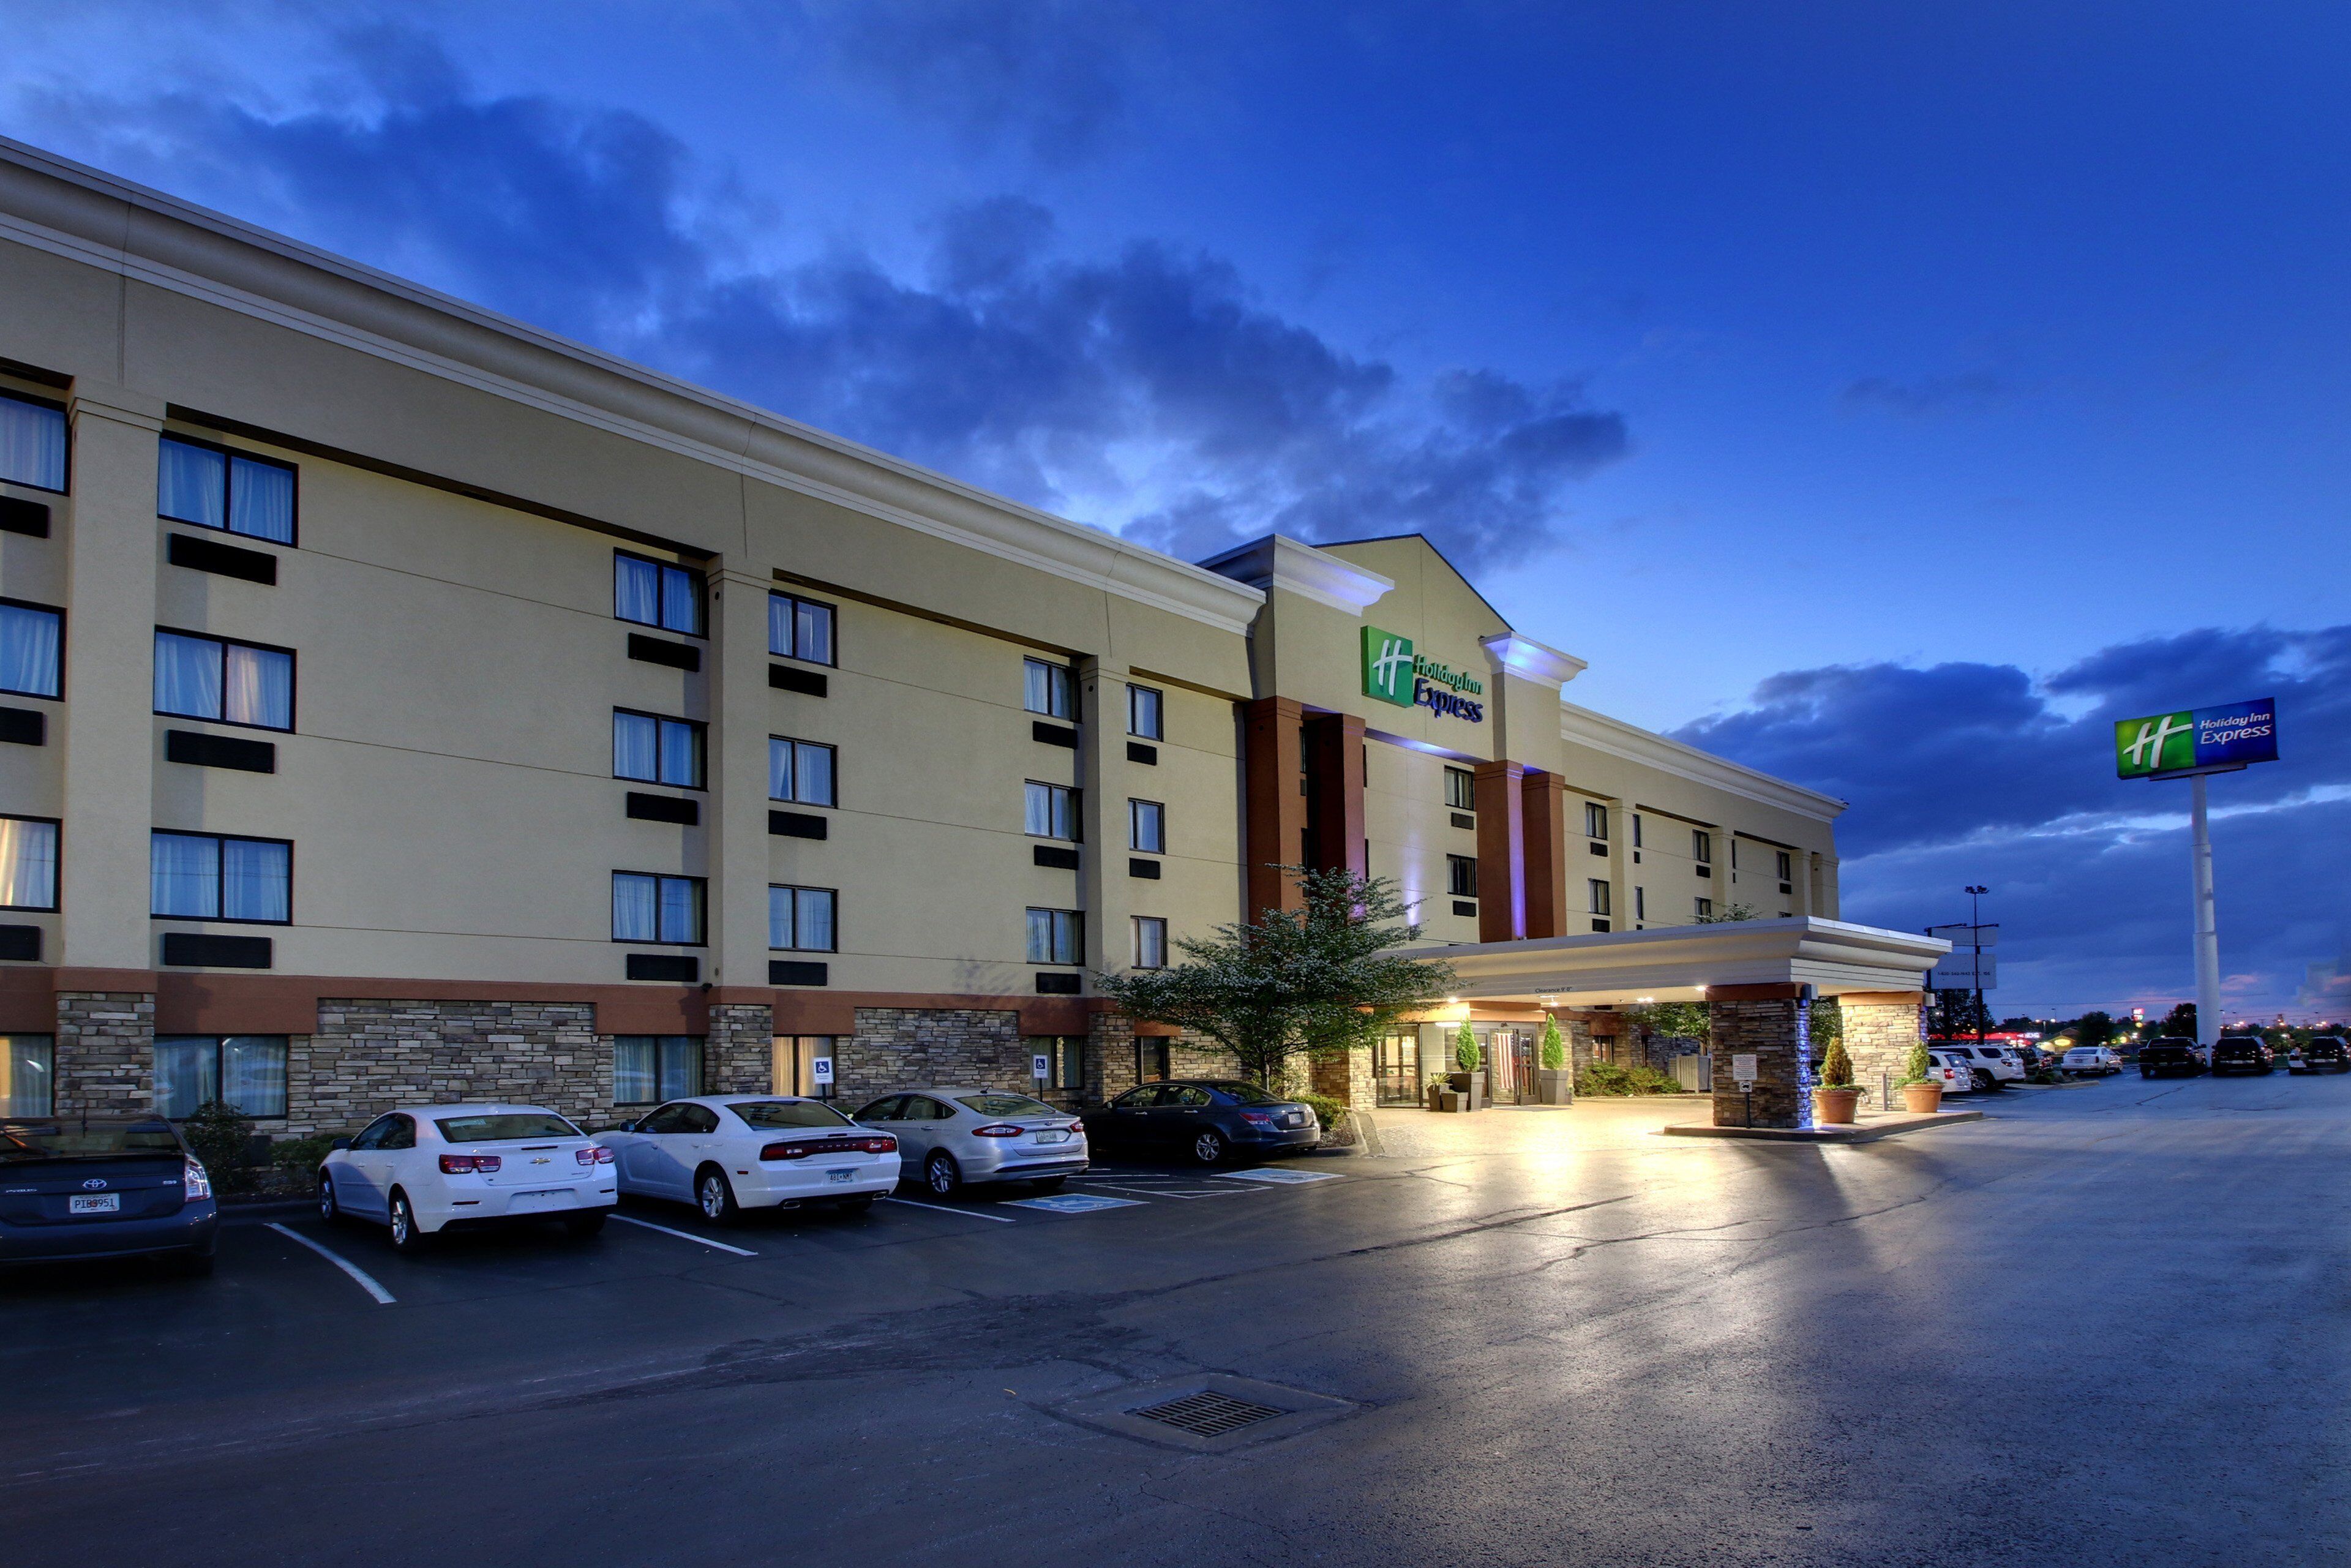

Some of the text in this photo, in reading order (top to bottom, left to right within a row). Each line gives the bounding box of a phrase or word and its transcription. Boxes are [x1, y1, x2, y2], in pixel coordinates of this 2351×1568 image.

[1414, 655, 1483, 694] Holiday Inn
[1414, 678, 1483, 722] Express
[2199, 713, 2270, 730] Holiday Inn
[2200, 724, 2272, 745] Express
